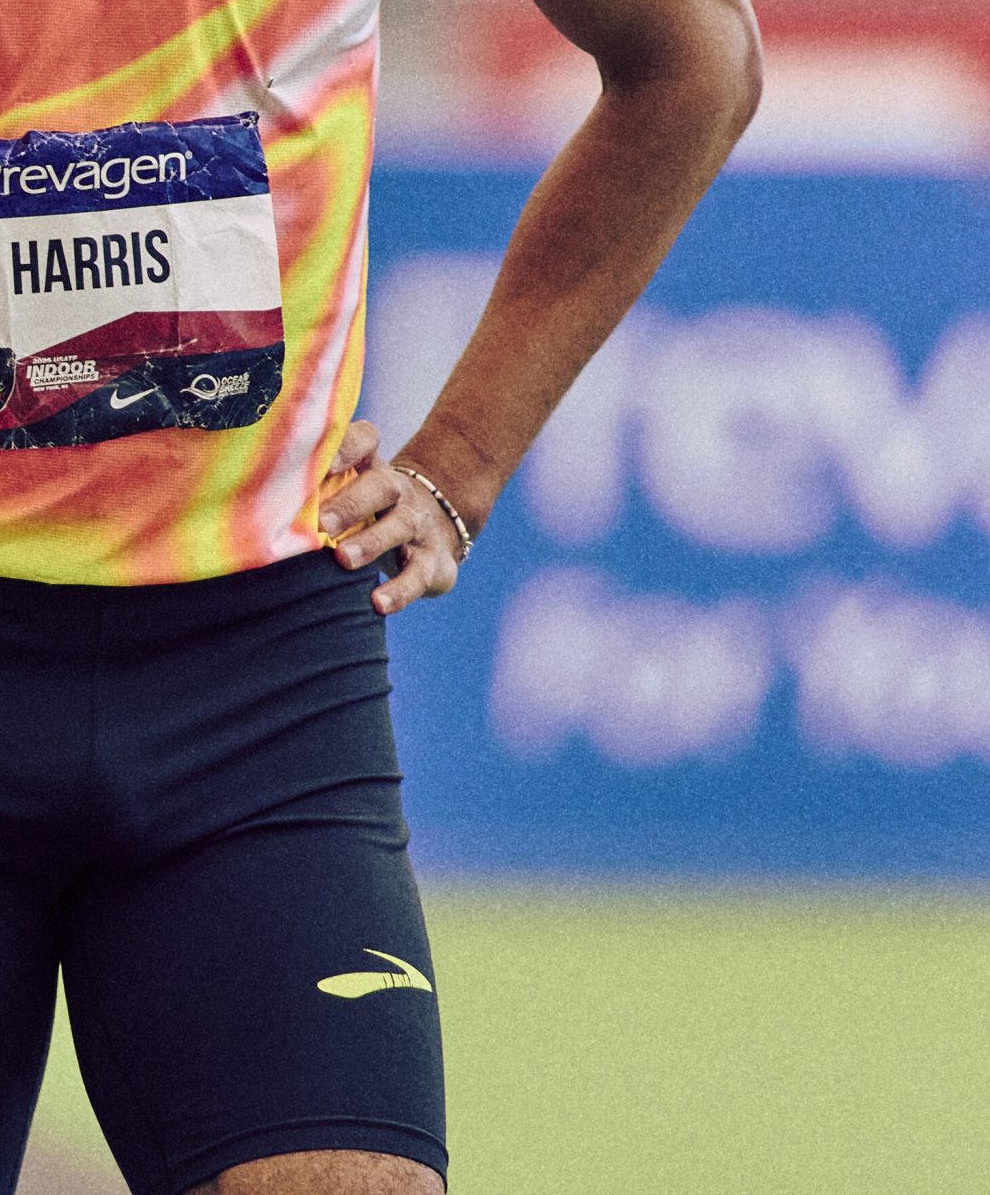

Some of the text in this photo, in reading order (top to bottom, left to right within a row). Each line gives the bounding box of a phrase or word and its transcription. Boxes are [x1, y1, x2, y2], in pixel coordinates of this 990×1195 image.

[11, 229, 171, 295] HARRIS
[26, 360, 96, 379] INDOOR
[34, 373, 96, 385] CHAMPIONSHIPS
